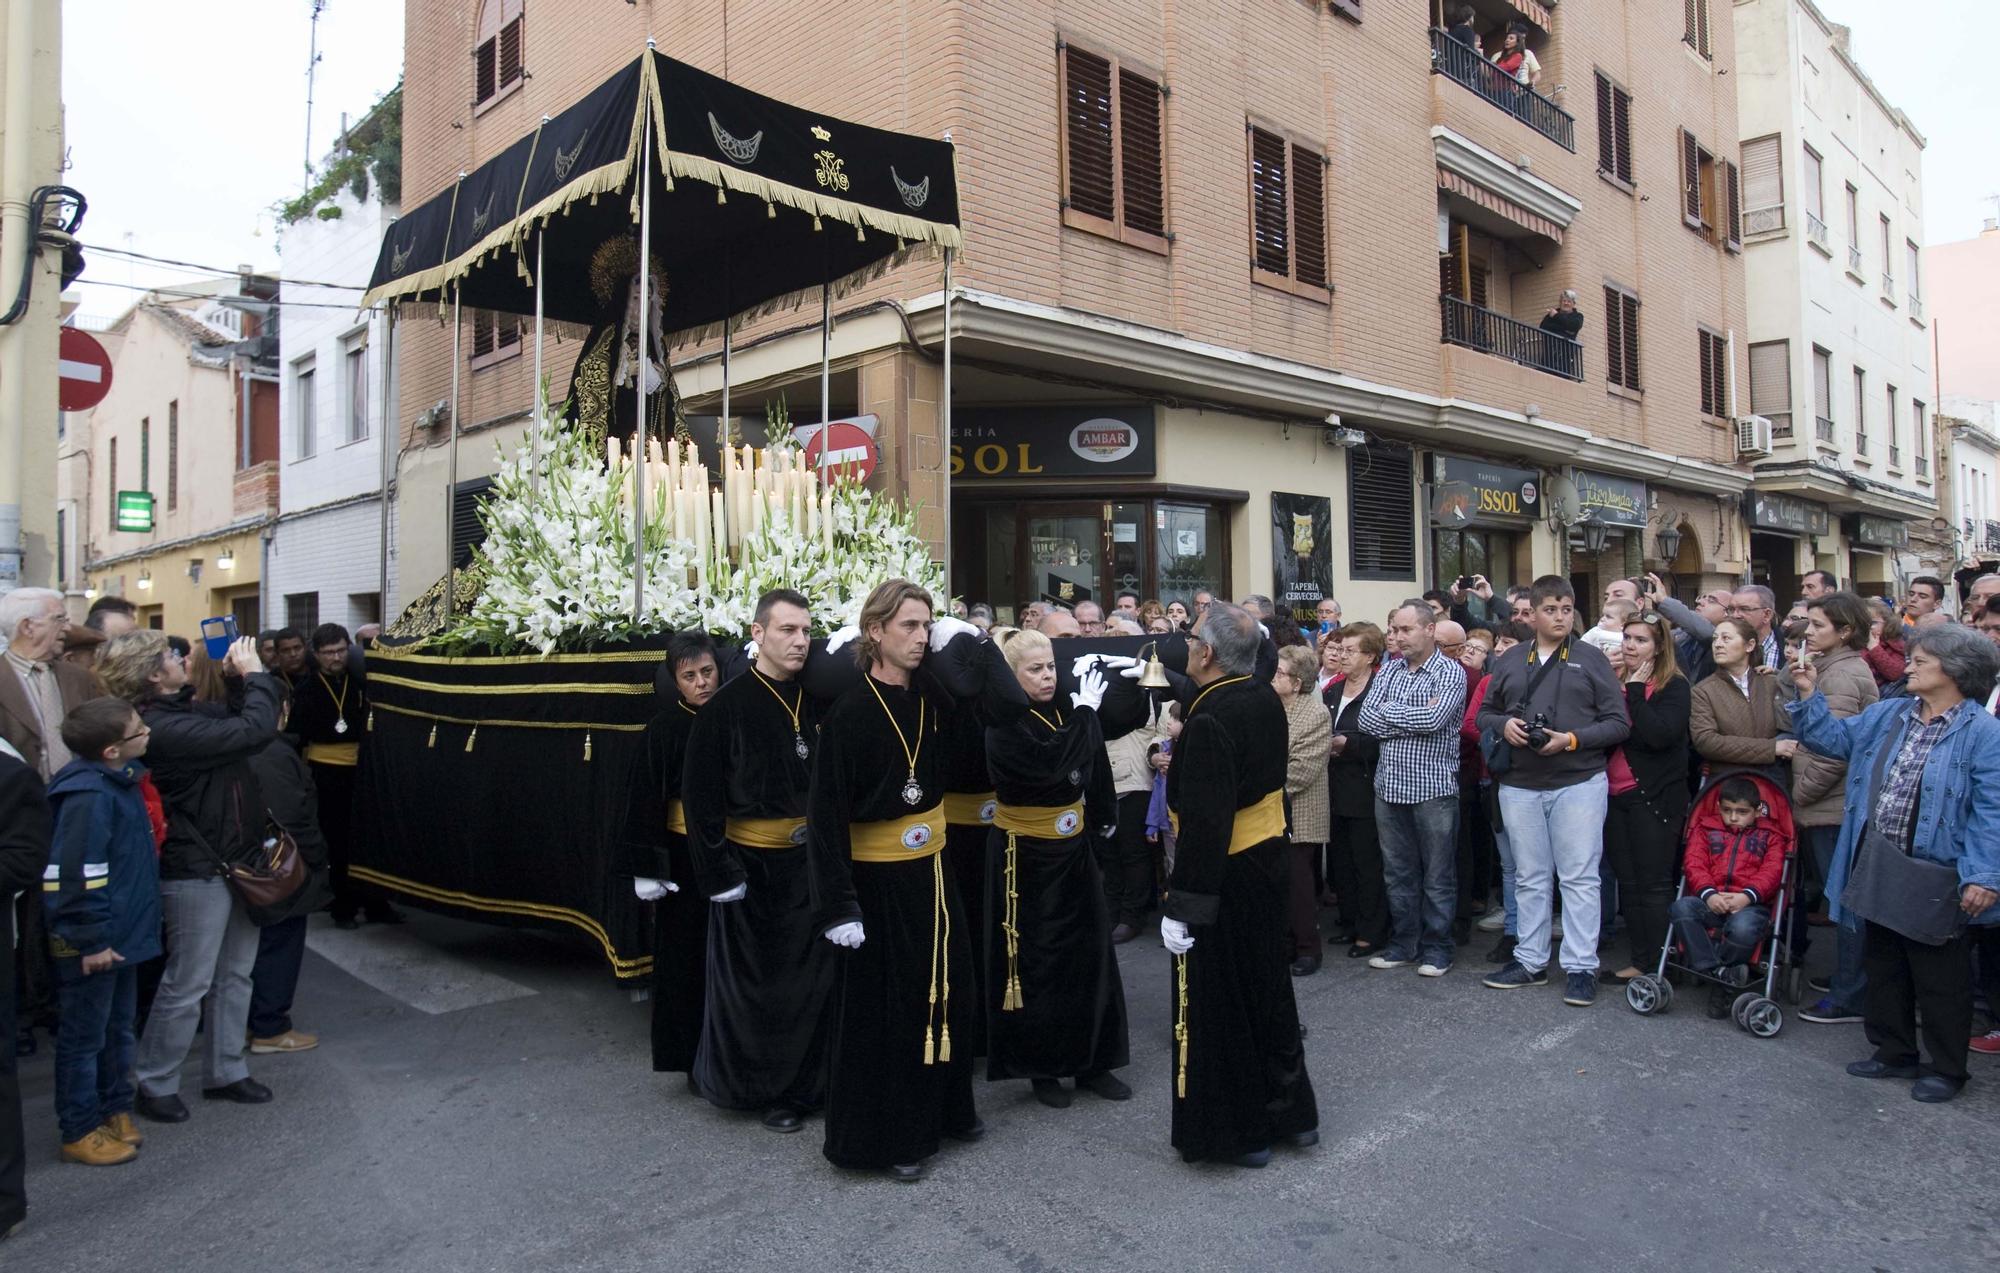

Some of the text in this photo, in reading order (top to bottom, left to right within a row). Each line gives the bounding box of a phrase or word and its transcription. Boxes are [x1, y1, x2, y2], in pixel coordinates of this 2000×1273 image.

[1082, 432, 1126, 445] AMBAR
[1290, 581, 1320, 591] TAPERÍA
[1286, 590, 1324, 600] CERVECERÍA
